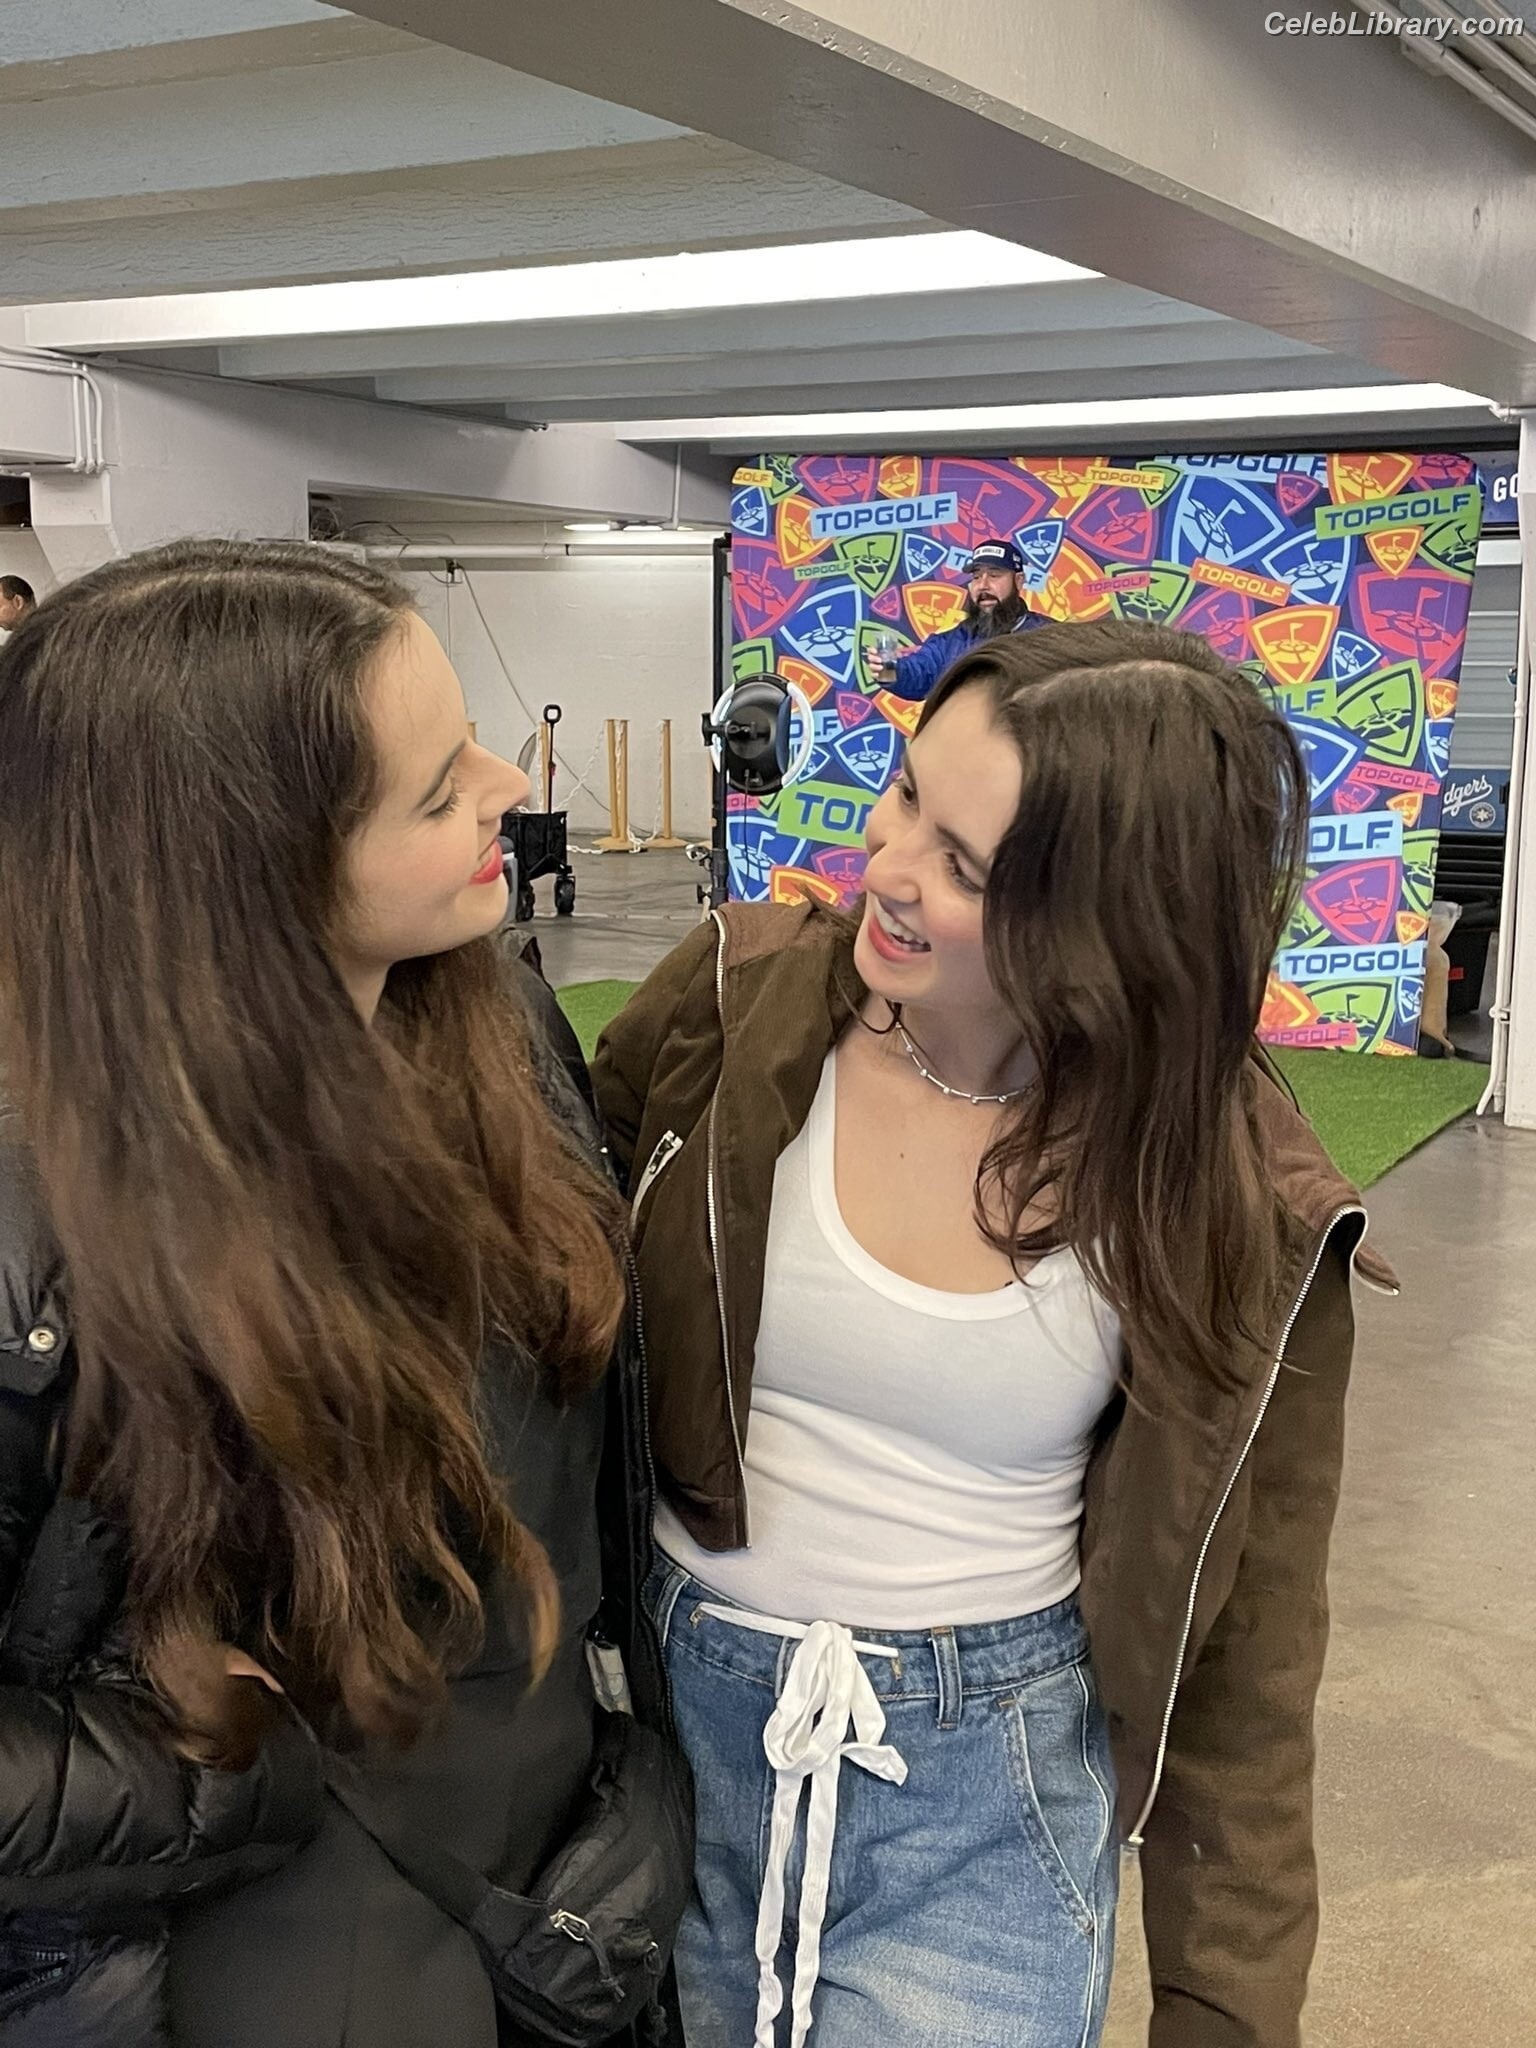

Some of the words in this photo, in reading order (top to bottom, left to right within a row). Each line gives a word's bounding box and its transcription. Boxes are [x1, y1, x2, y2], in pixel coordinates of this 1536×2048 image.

[1090, 469, 1161, 486] TOPGOLF
[816, 499, 952, 533] TOPGOLF
[1325, 493, 1471, 531] TOPGOLF
[797, 562, 851, 577] TOPGOLF
[1198, 563, 1286, 599] TOPGOLF
[1086, 575, 1147, 594] TOPGOLF
[1356, 765, 1436, 789] TOPGOLF
[1285, 948, 1427, 976] TOPGOL
